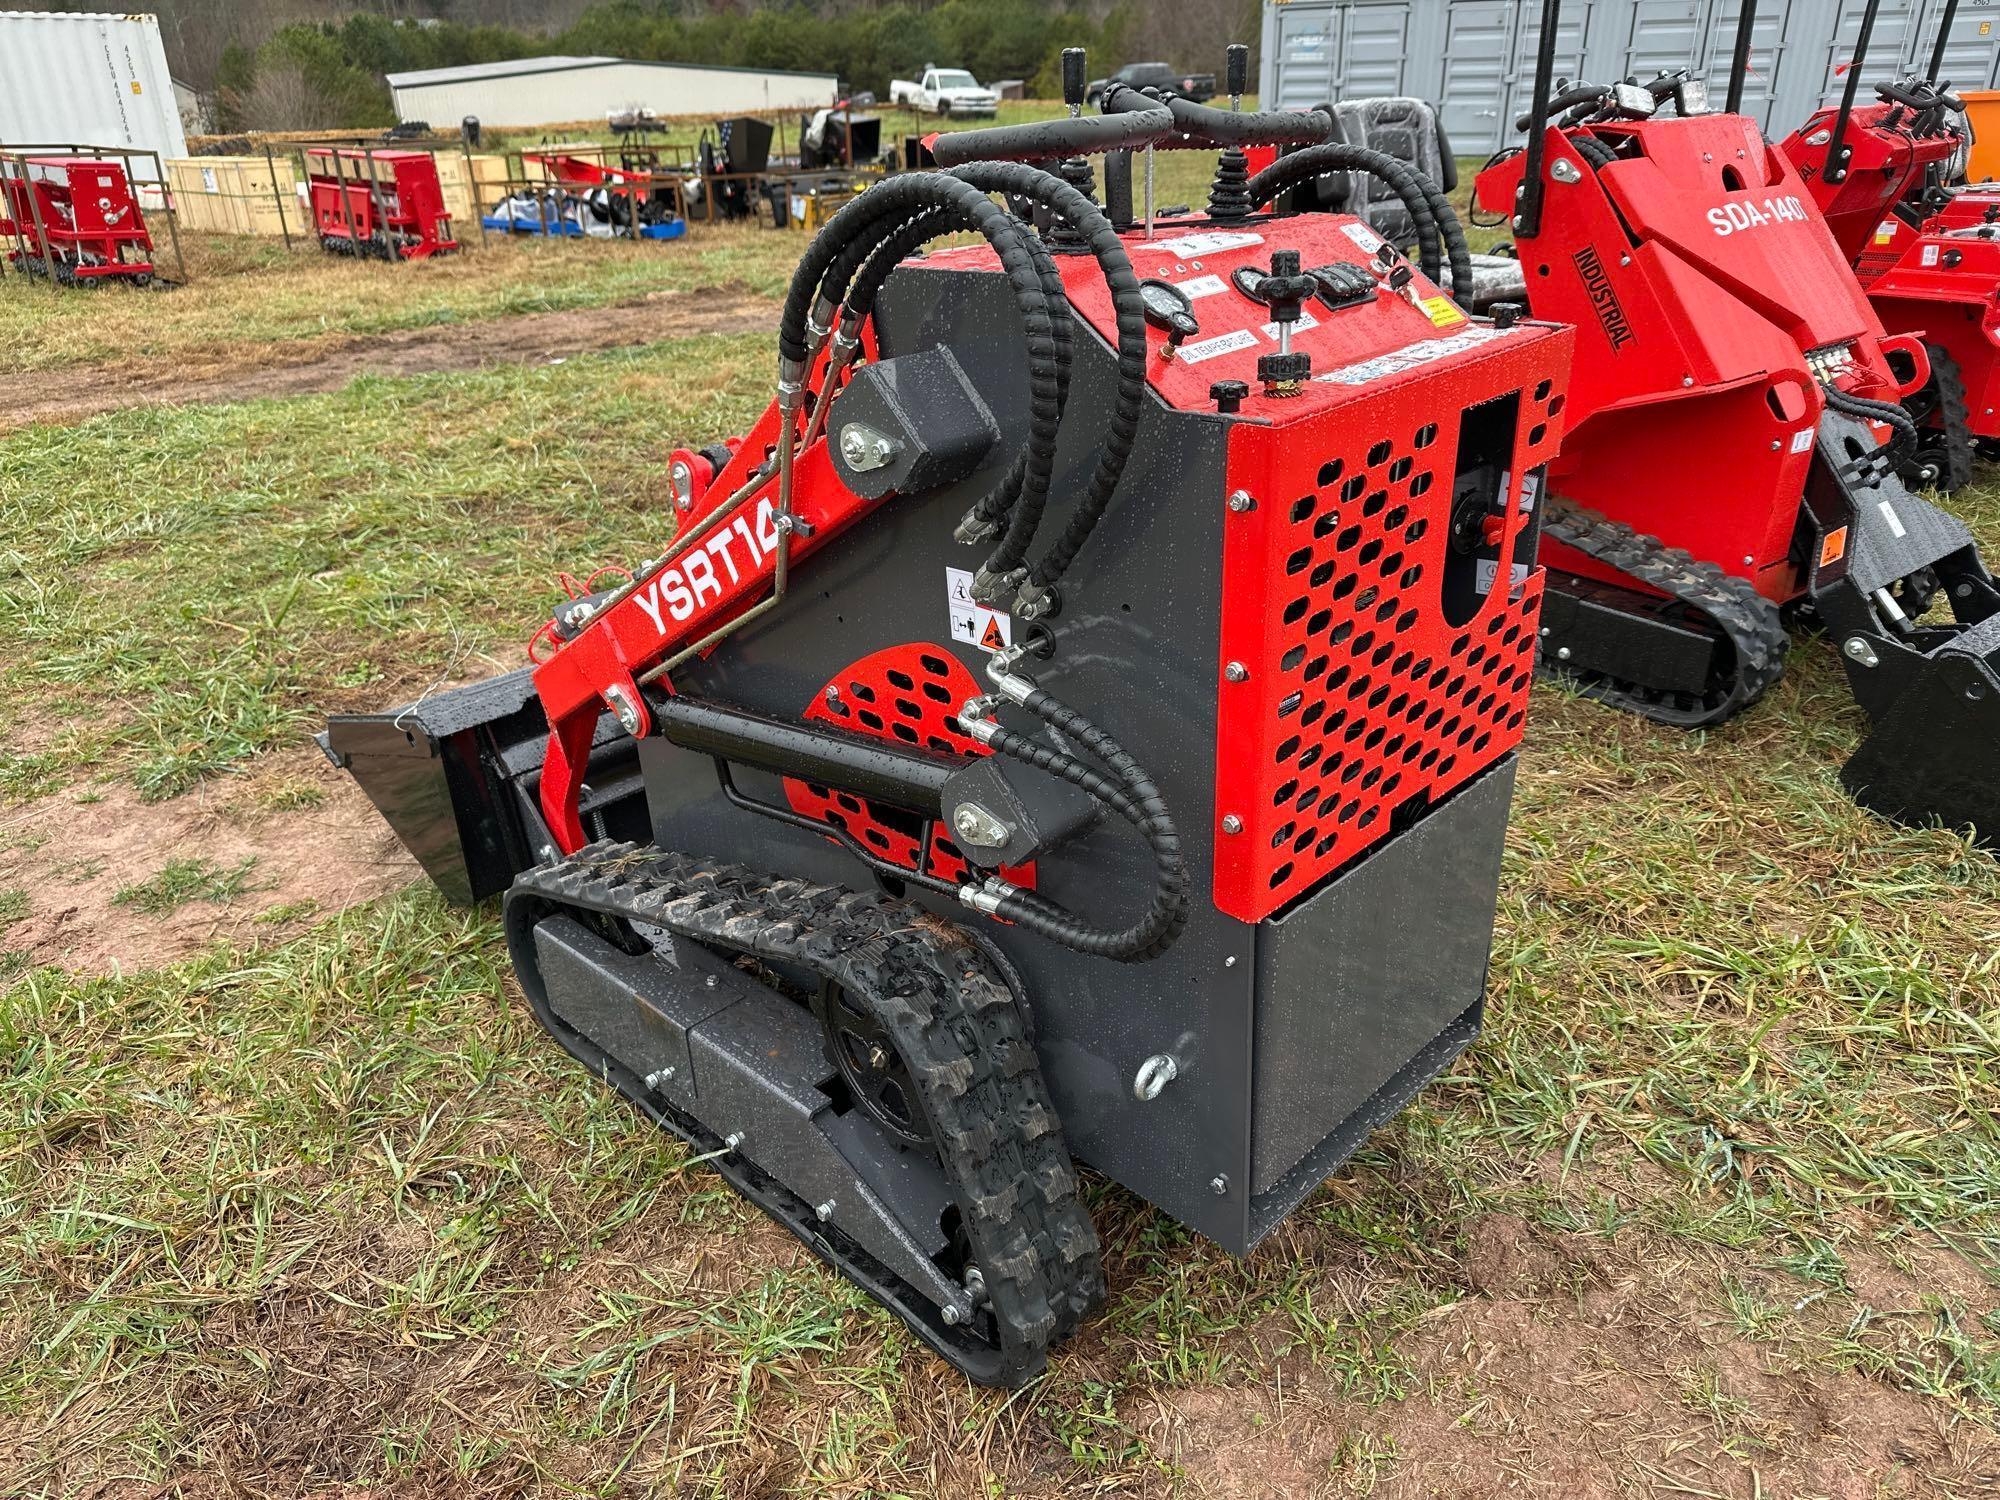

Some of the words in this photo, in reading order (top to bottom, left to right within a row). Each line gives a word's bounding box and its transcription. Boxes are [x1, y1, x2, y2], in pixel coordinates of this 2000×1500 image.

[1706, 195, 1809, 236] SDA-140T
[1575, 246, 1633, 350] INDUSTRIAL
[1194, 333, 1255, 356] TEMPERATURE
